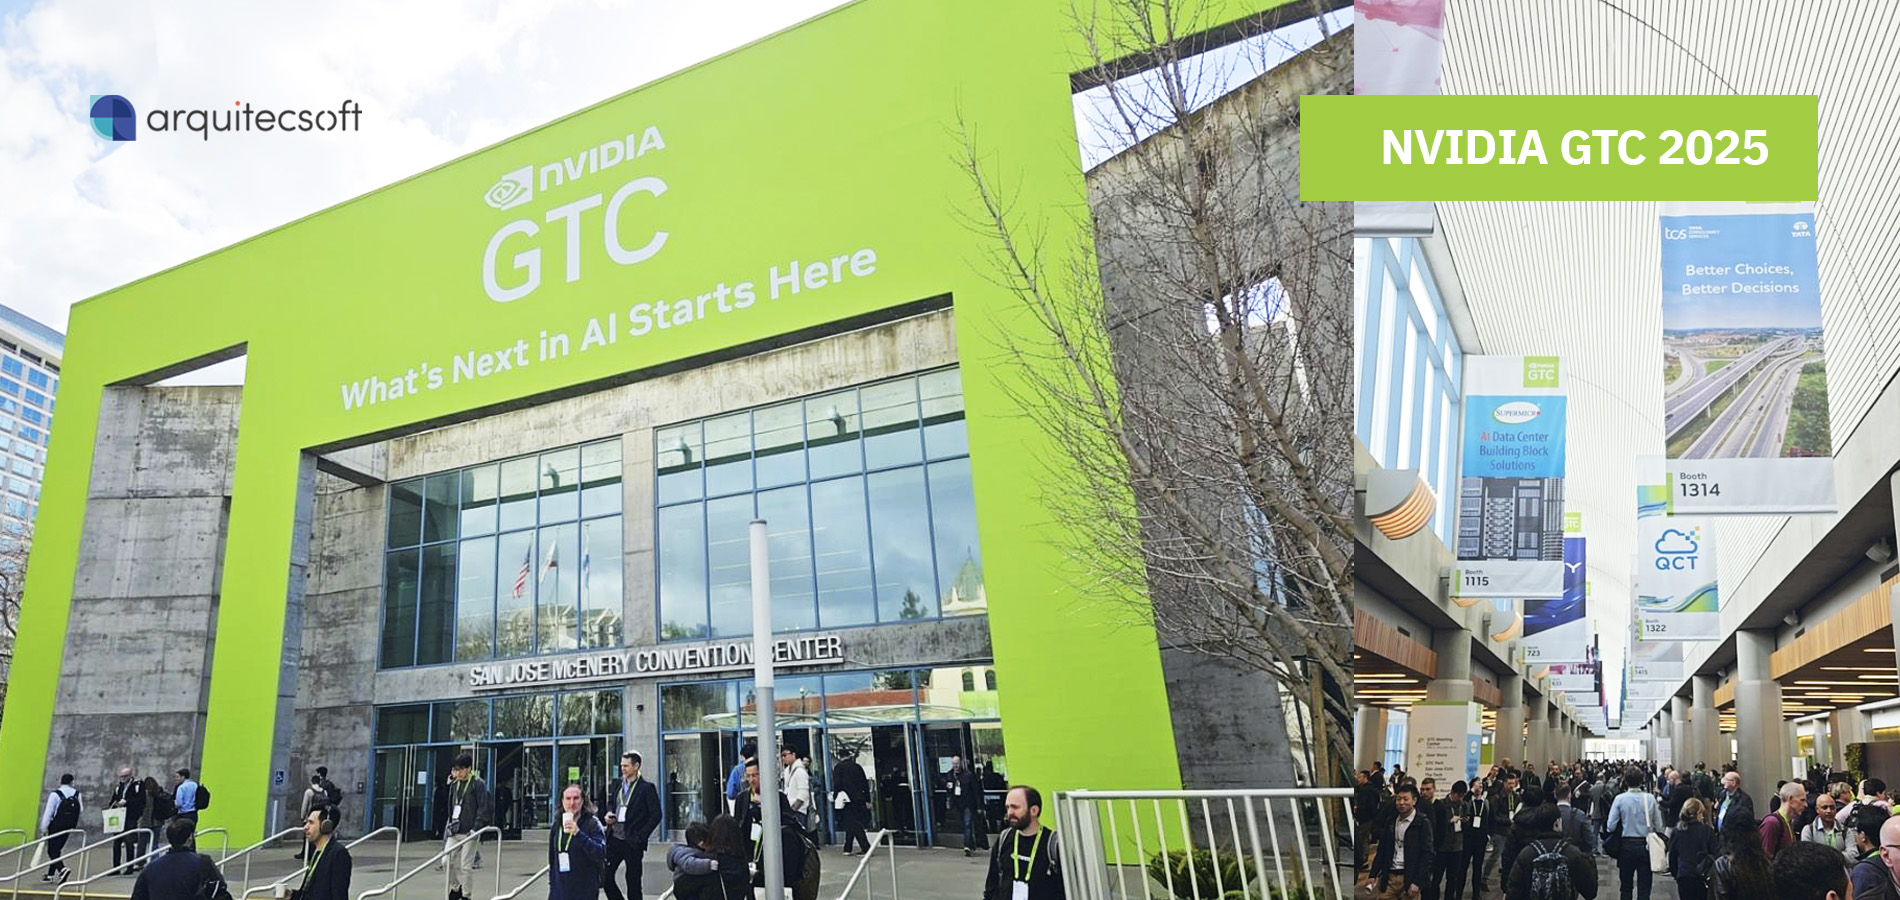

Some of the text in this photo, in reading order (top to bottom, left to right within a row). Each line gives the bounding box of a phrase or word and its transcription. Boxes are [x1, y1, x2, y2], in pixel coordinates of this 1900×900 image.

[482, 176, 669, 303] GTC
[1685, 262, 1794, 277] Better Choices,
[1682, 281, 1800, 296] Better Decisions
[340, 247, 877, 411] What's Next in AI Starts Here
[1527, 369, 1555, 381] GTC
[1492, 431, 1516, 442] Data
[1517, 431, 1549, 442] Center
[1479, 445, 1549, 459] Building Block
[1489, 460, 1537, 471] Solutions
[1679, 472, 1708, 480] Booth
[1680, 483, 1721, 497] 1314
[1655, 555, 1699, 571] QCT
[1464, 576, 1489, 587] 1115
[1645, 624, 1667, 633] 1322
[469, 635, 843, 686] SAN JOSE McENERY CONVENTION ENTER
